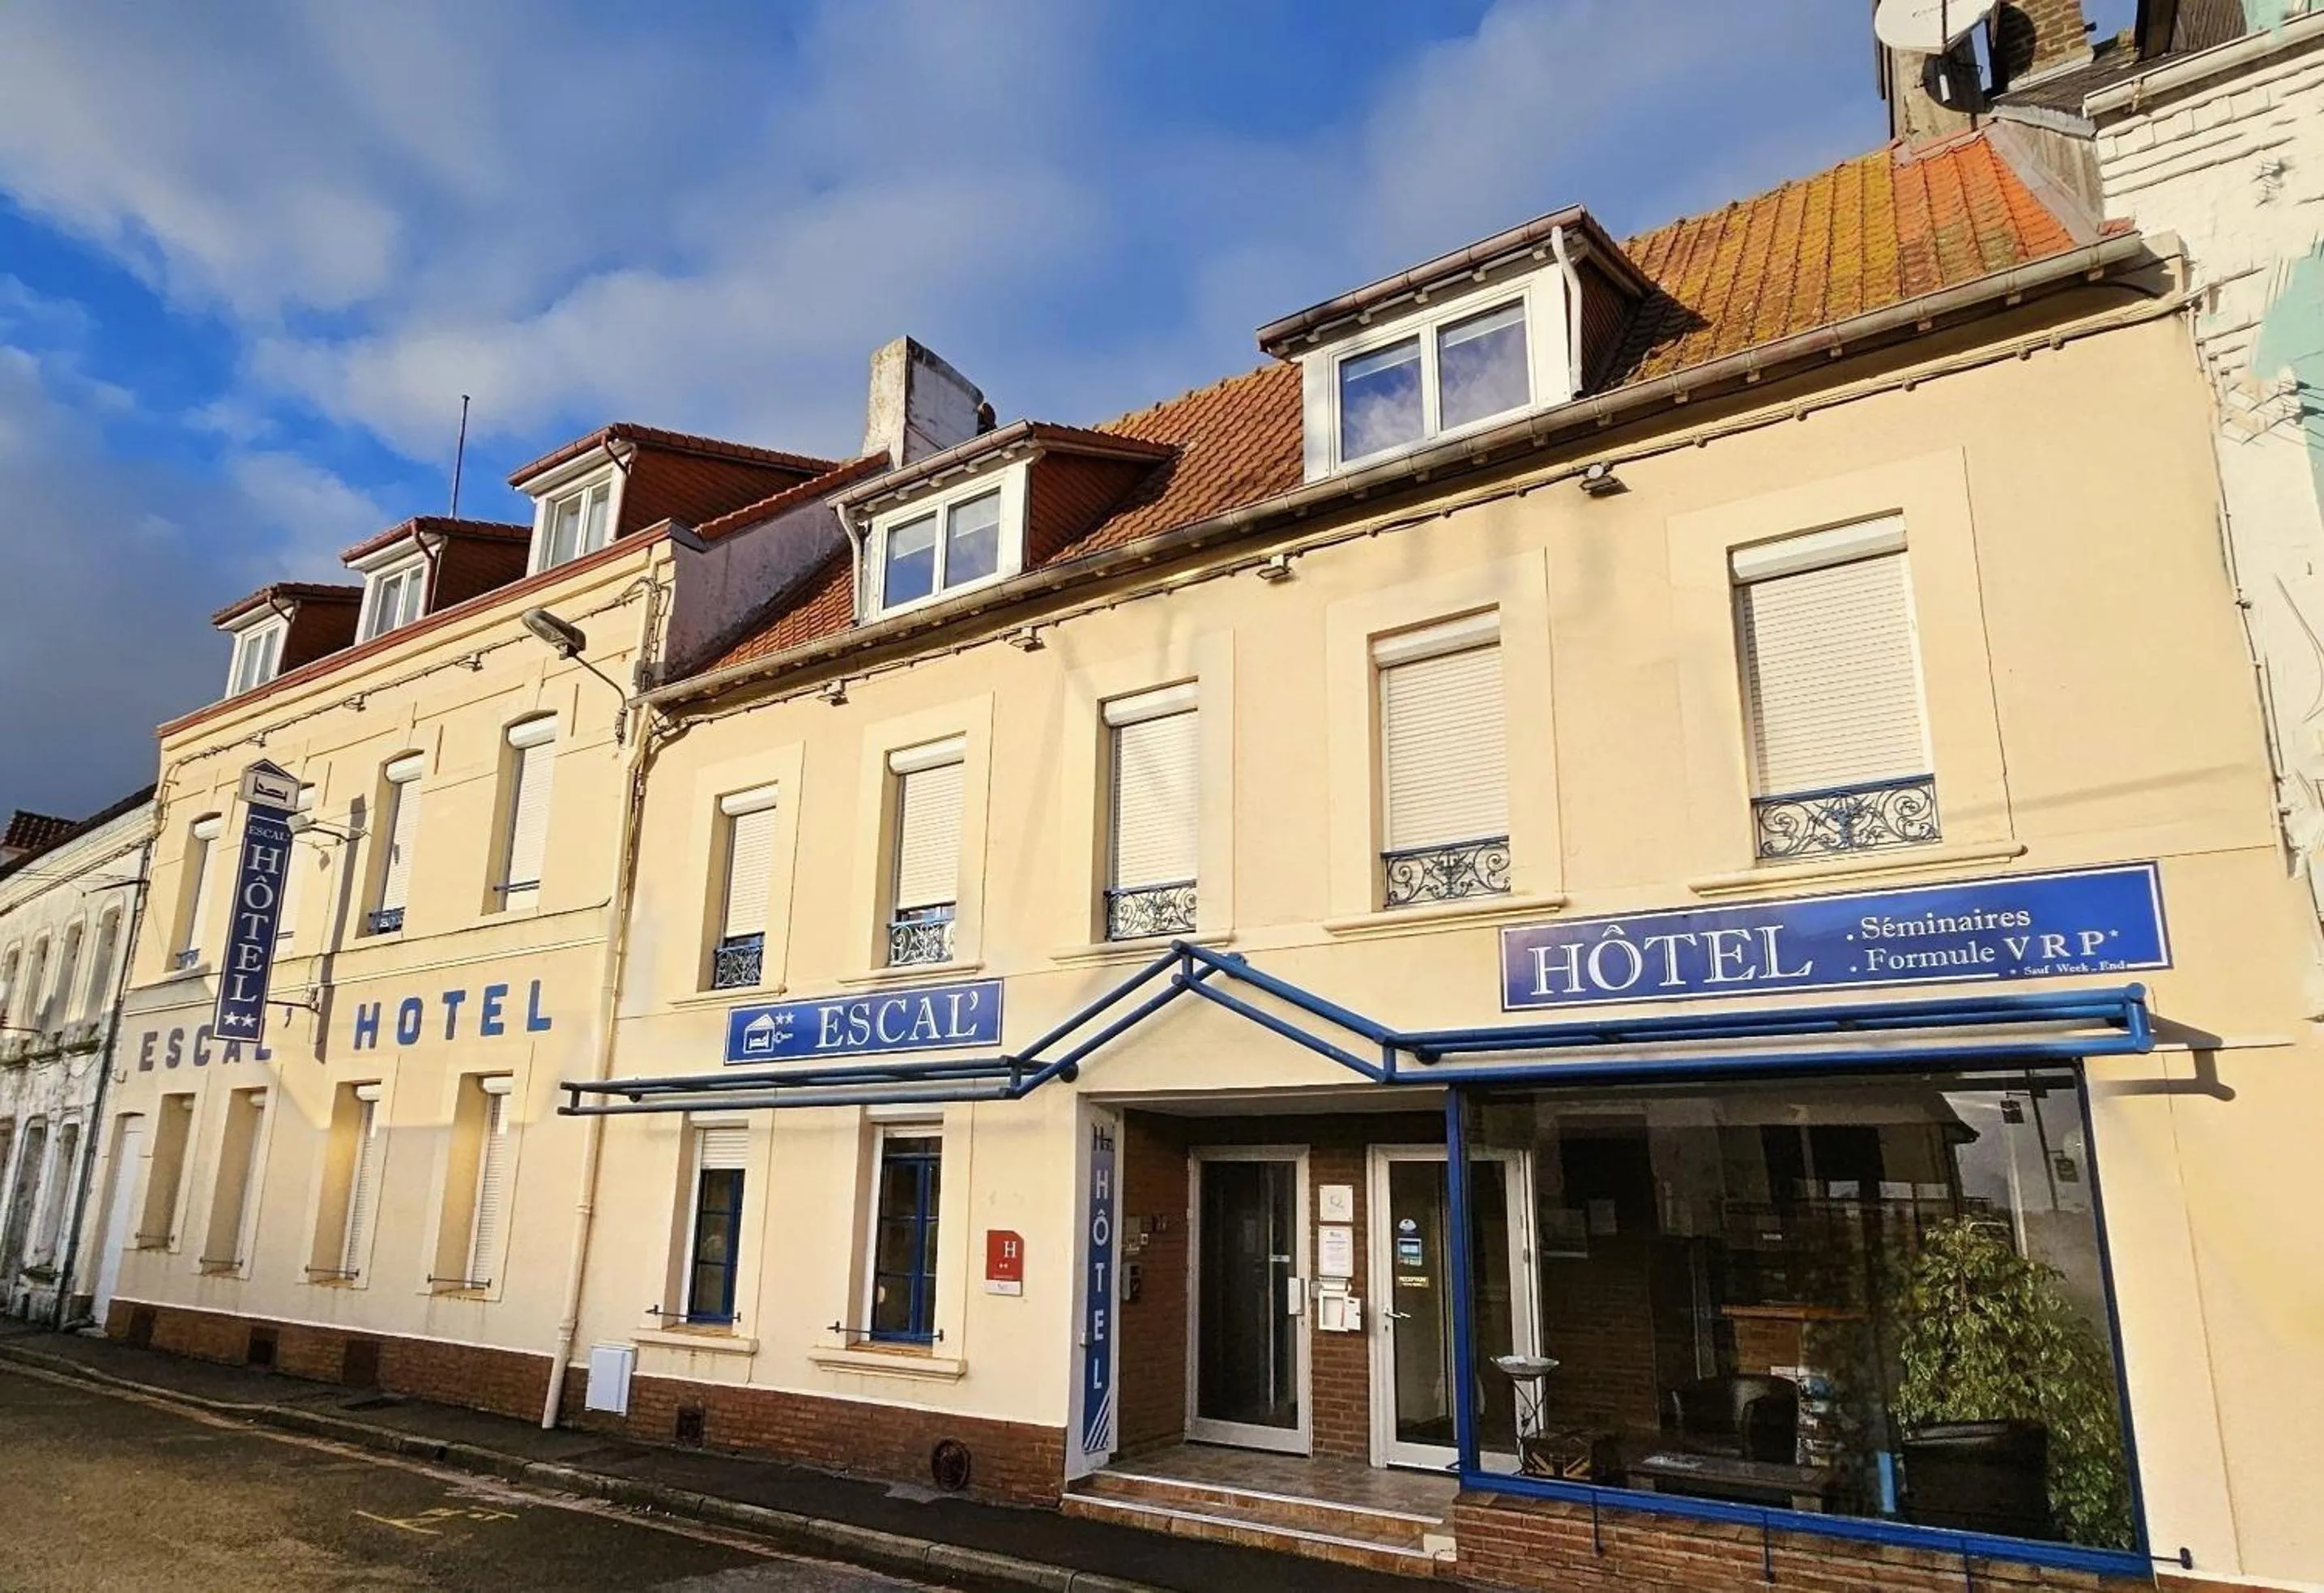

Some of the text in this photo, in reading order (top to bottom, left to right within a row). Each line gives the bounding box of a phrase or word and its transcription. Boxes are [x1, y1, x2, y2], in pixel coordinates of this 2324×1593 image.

[229, 843, 282, 1002] HÔTEL
[1861, 908, 2031, 940] Séminaires
[1528, 925, 1813, 996] HÔTEL
[1865, 941, 1995, 972] Formule
[2023, 965, 2050, 976] Sauf
[353, 980, 552, 1051] HOTEL
[815, 990, 979, 1049] ESCAL'
[1004, 1241, 1017, 1258] H
[1093, 1169, 1109, 1389] HÔTEL
